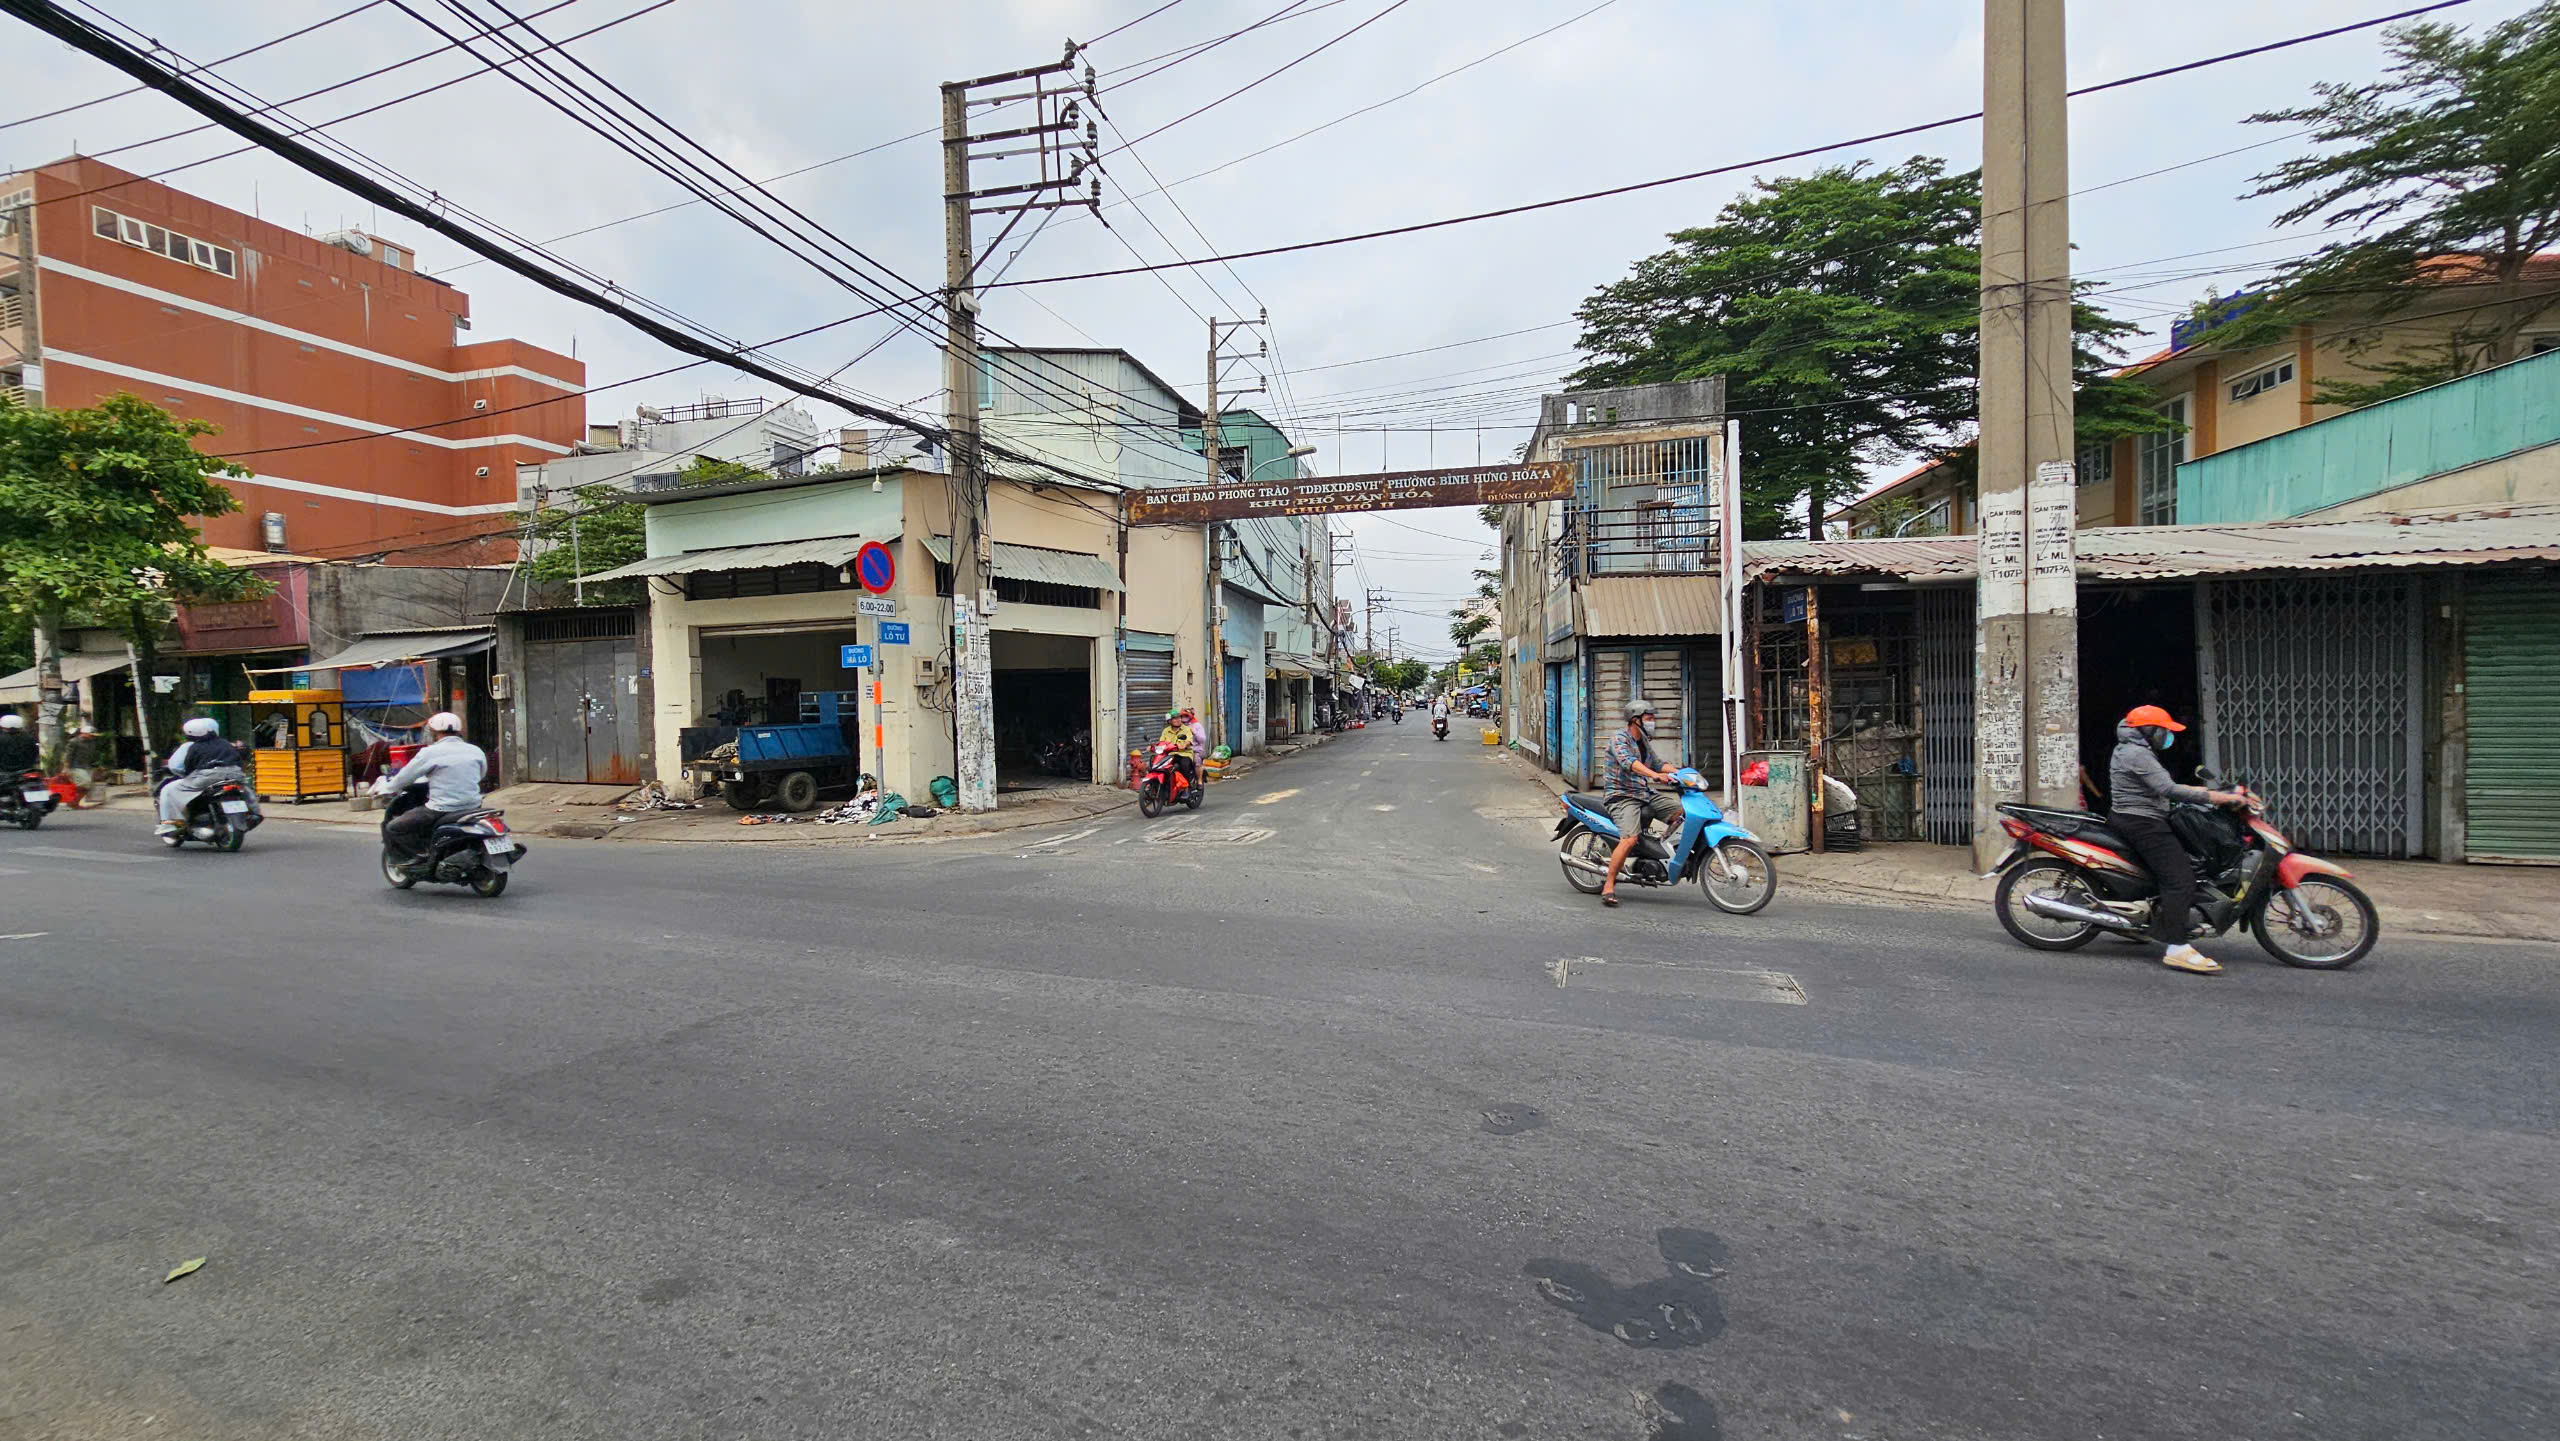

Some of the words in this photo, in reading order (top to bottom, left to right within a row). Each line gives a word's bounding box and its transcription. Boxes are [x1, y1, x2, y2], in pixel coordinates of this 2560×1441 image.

[1146, 495, 1168, 505] BAN
[1193, 492, 1215, 503] ĐẠO
[1218, 489, 1255, 500] PHONG
[1259, 484, 1289, 497] TRÀO
[1387, 474, 1436, 490] PHƯỜNG
[1439, 472, 1470, 486] BÌNH
[1473, 472, 1508, 484] HƯNG
[1511, 468, 1539, 481] HÒA
[1542, 469, 1551, 479] A
[1249, 499, 1290, 508] KHU
[1296, 494, 1335, 506] PHỐ
[1342, 492, 1383, 502] VĂN
[1390, 488, 1434, 500] HÓA
[1488, 492, 1522, 502] ĐƯỜNG
[1284, 505, 1326, 515] KHU
[1333, 500, 1372, 512] PHỐ
